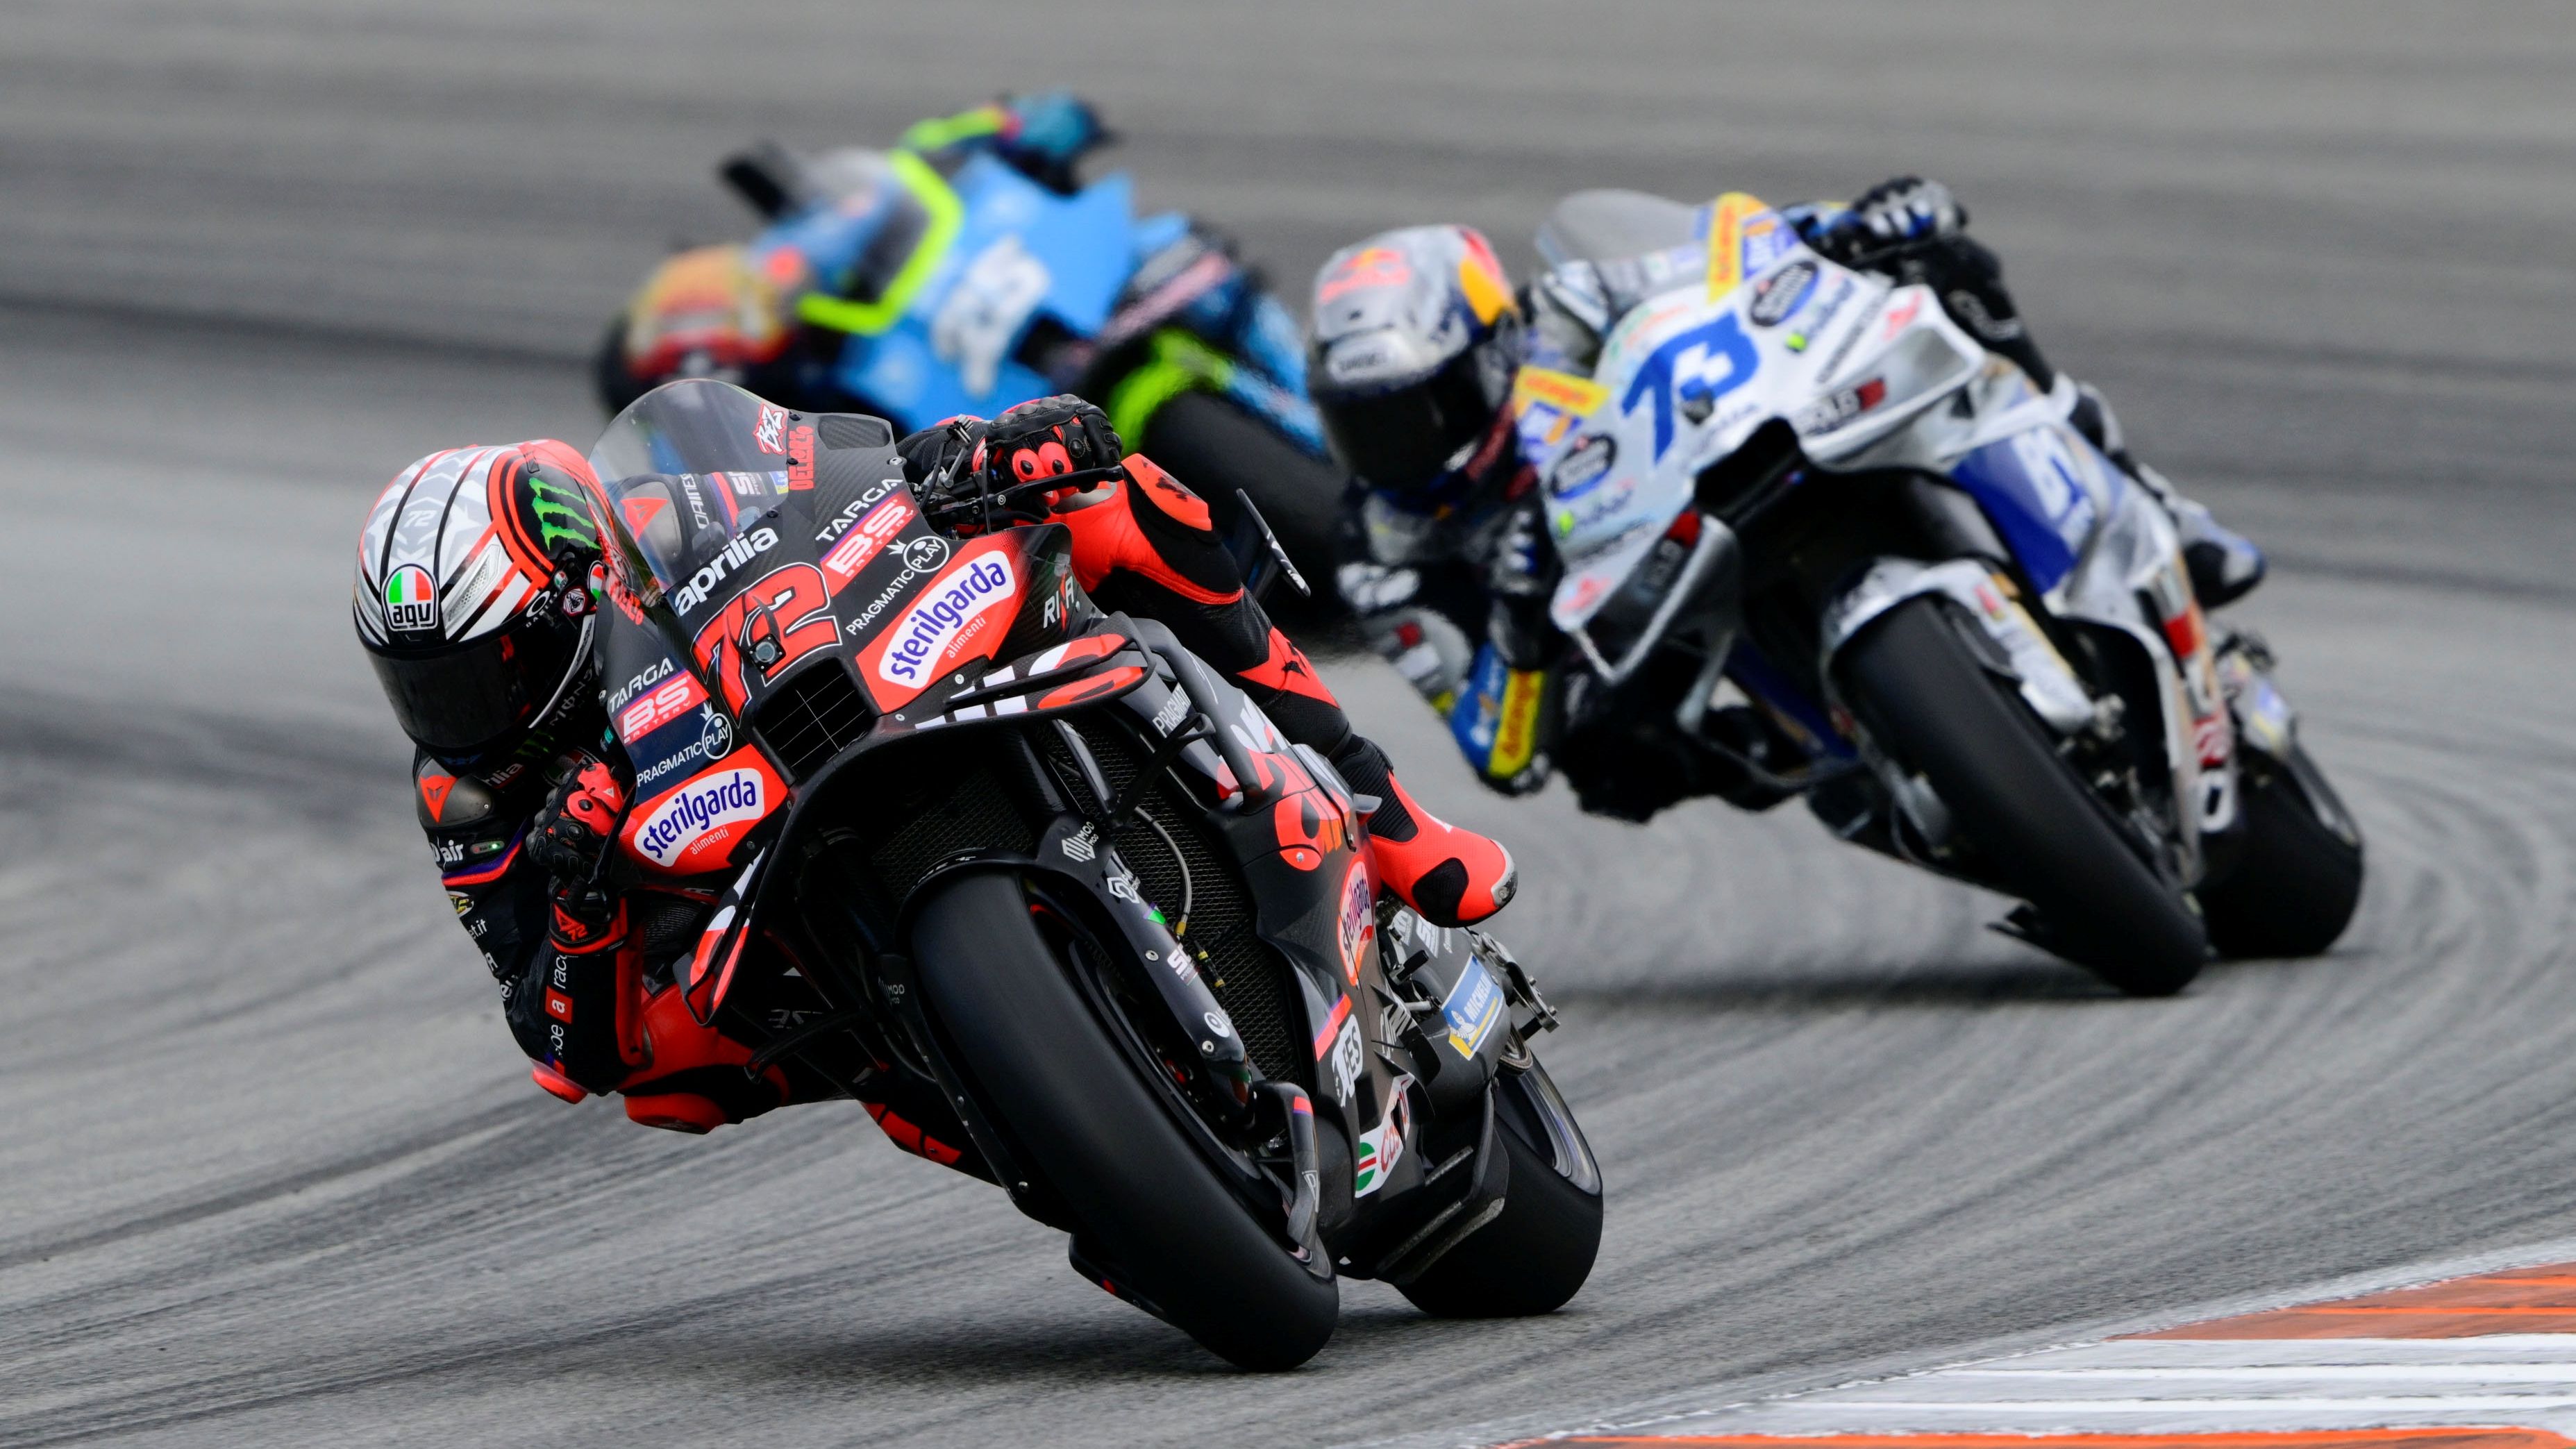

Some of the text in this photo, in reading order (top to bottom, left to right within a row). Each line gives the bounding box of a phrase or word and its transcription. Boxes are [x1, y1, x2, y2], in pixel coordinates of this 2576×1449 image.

[1621, 310, 1761, 465] 73
[403, 510, 437, 528] 72
[815, 477, 903, 544] TARGA
[826, 499, 907, 575] BS
[674, 526, 780, 617] aprilia
[845, 538, 942, 636] PRAGMATIC PLAY
[392, 603, 431, 630] agv
[689, 561, 843, 729] 72
[891, 562, 1007, 680] sterilgarda
[946, 615, 987, 660] alimenti
[608, 657, 674, 713] TARGA
[624, 676, 691, 737] BS
[636, 724, 729, 788] PRAGMATIC PLAY
[643, 771, 758, 860] sterilgarda
[689, 826, 730, 855] alimenti
[567, 923, 588, 941] 72
